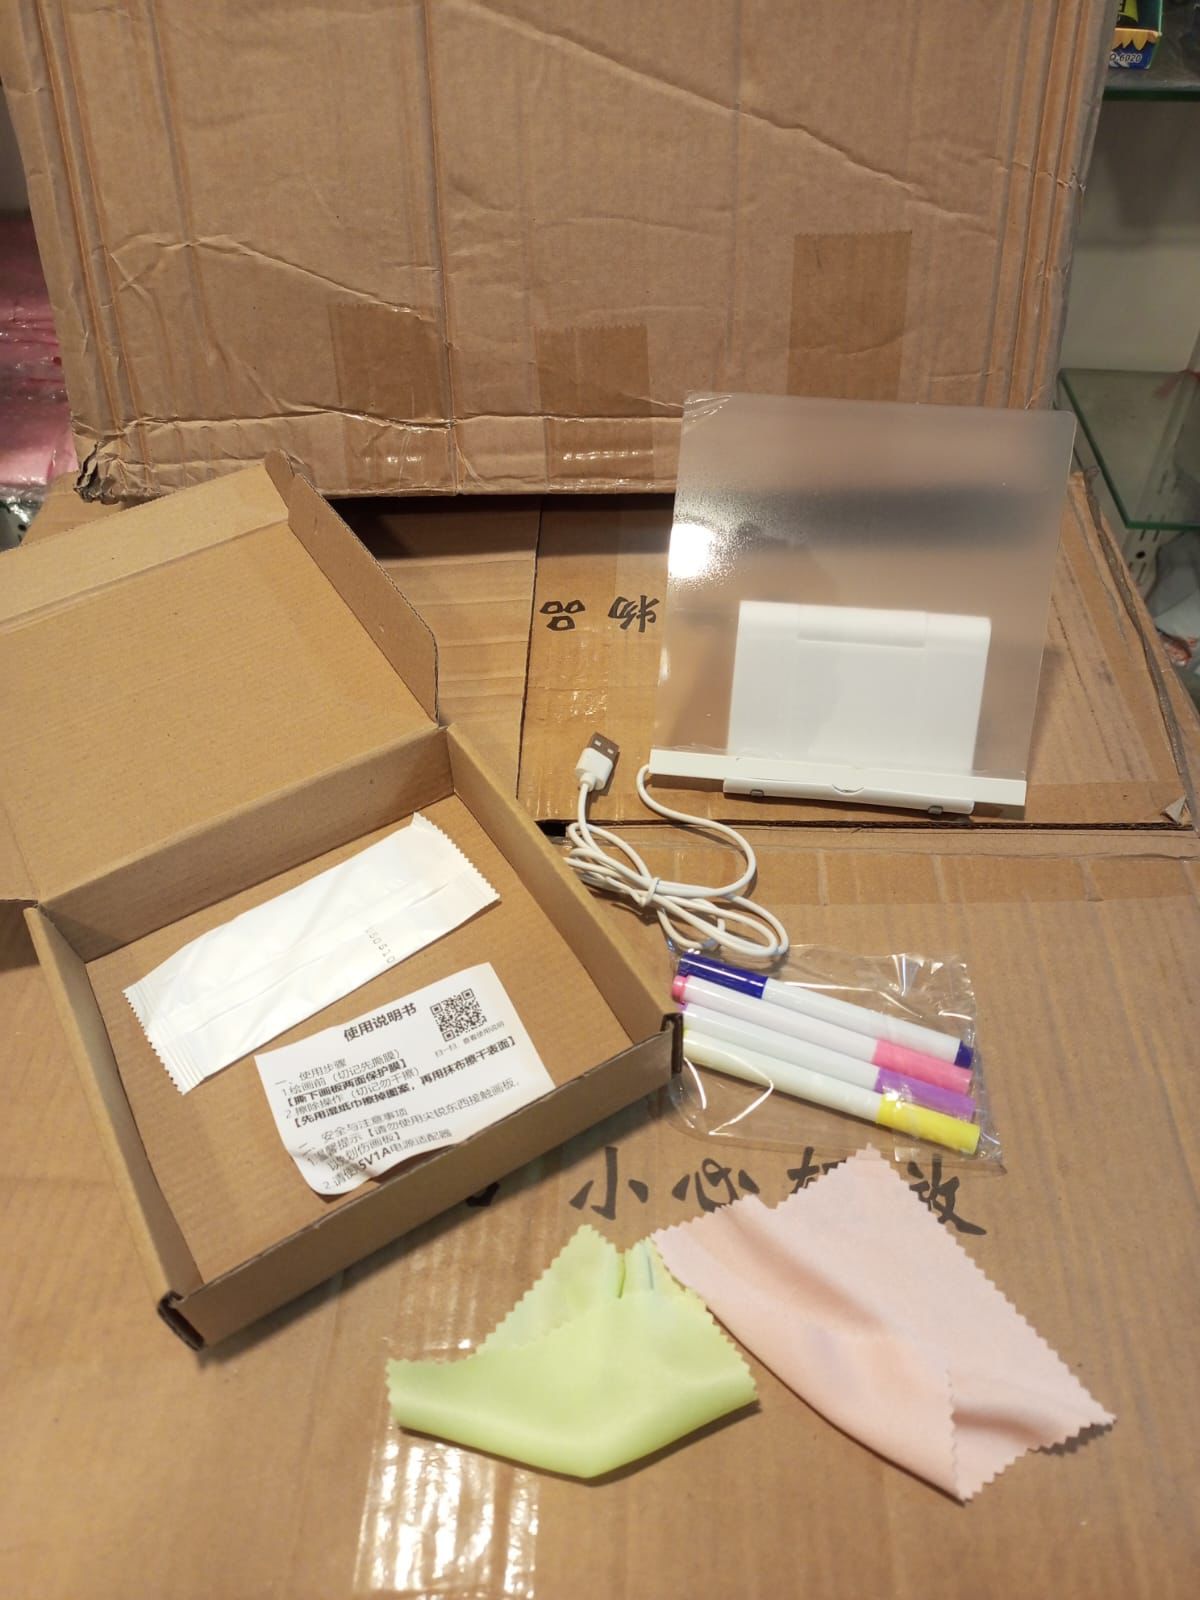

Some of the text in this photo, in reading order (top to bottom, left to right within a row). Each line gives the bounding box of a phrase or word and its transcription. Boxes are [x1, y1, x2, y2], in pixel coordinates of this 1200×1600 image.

[539, 594, 661, 633] 物品
[343, 1002, 418, 1043] 使用说明书
[570, 1146, 987, 1235] 小心放
